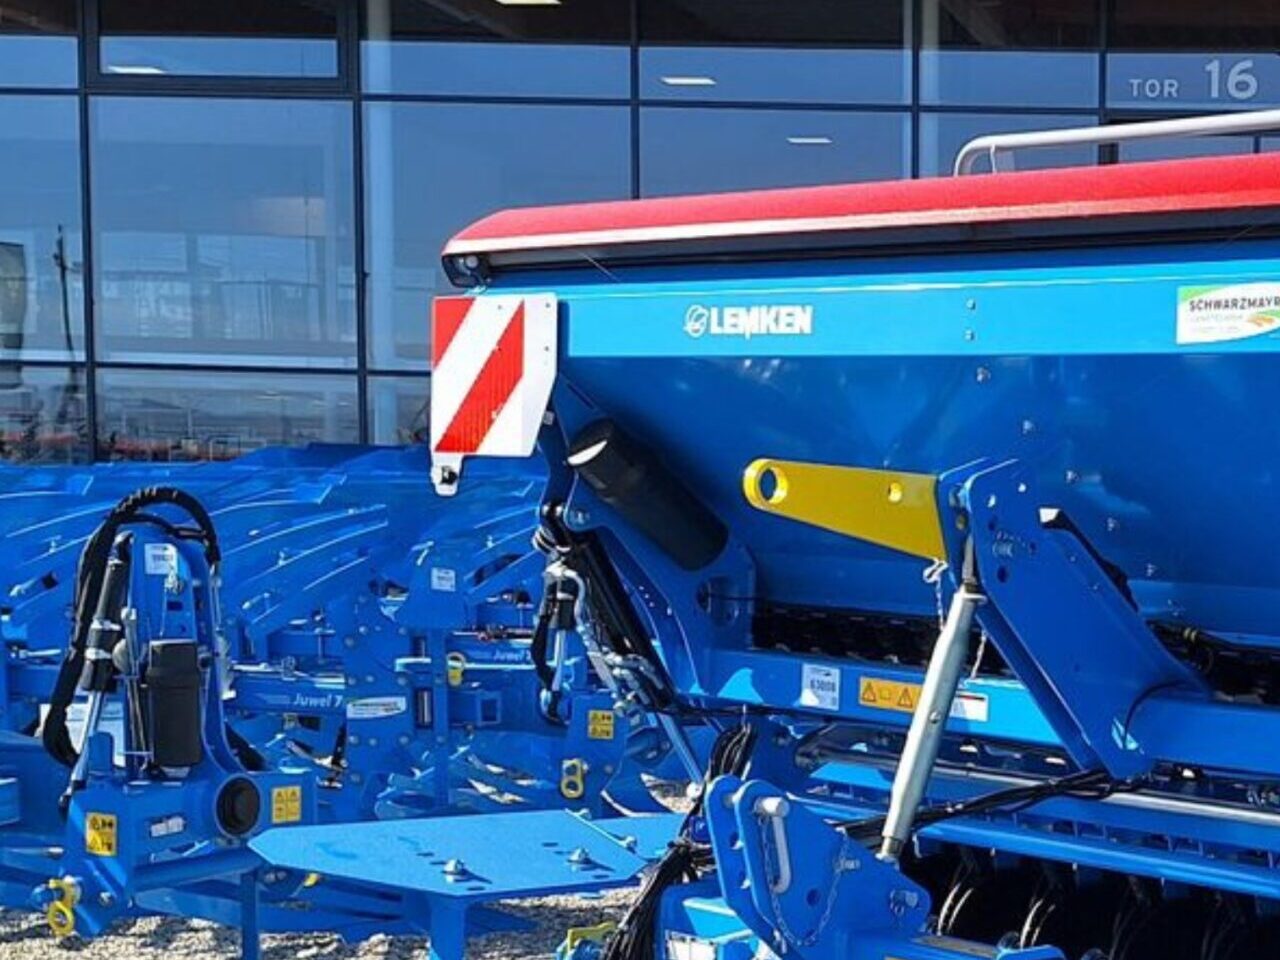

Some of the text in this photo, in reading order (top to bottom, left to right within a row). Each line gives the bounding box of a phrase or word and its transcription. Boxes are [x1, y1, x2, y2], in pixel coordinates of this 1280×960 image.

[1129, 59, 1259, 99] TOR 16
[710, 304, 813, 340] LEMKEN
[294, 692, 332, 708] Juwel
